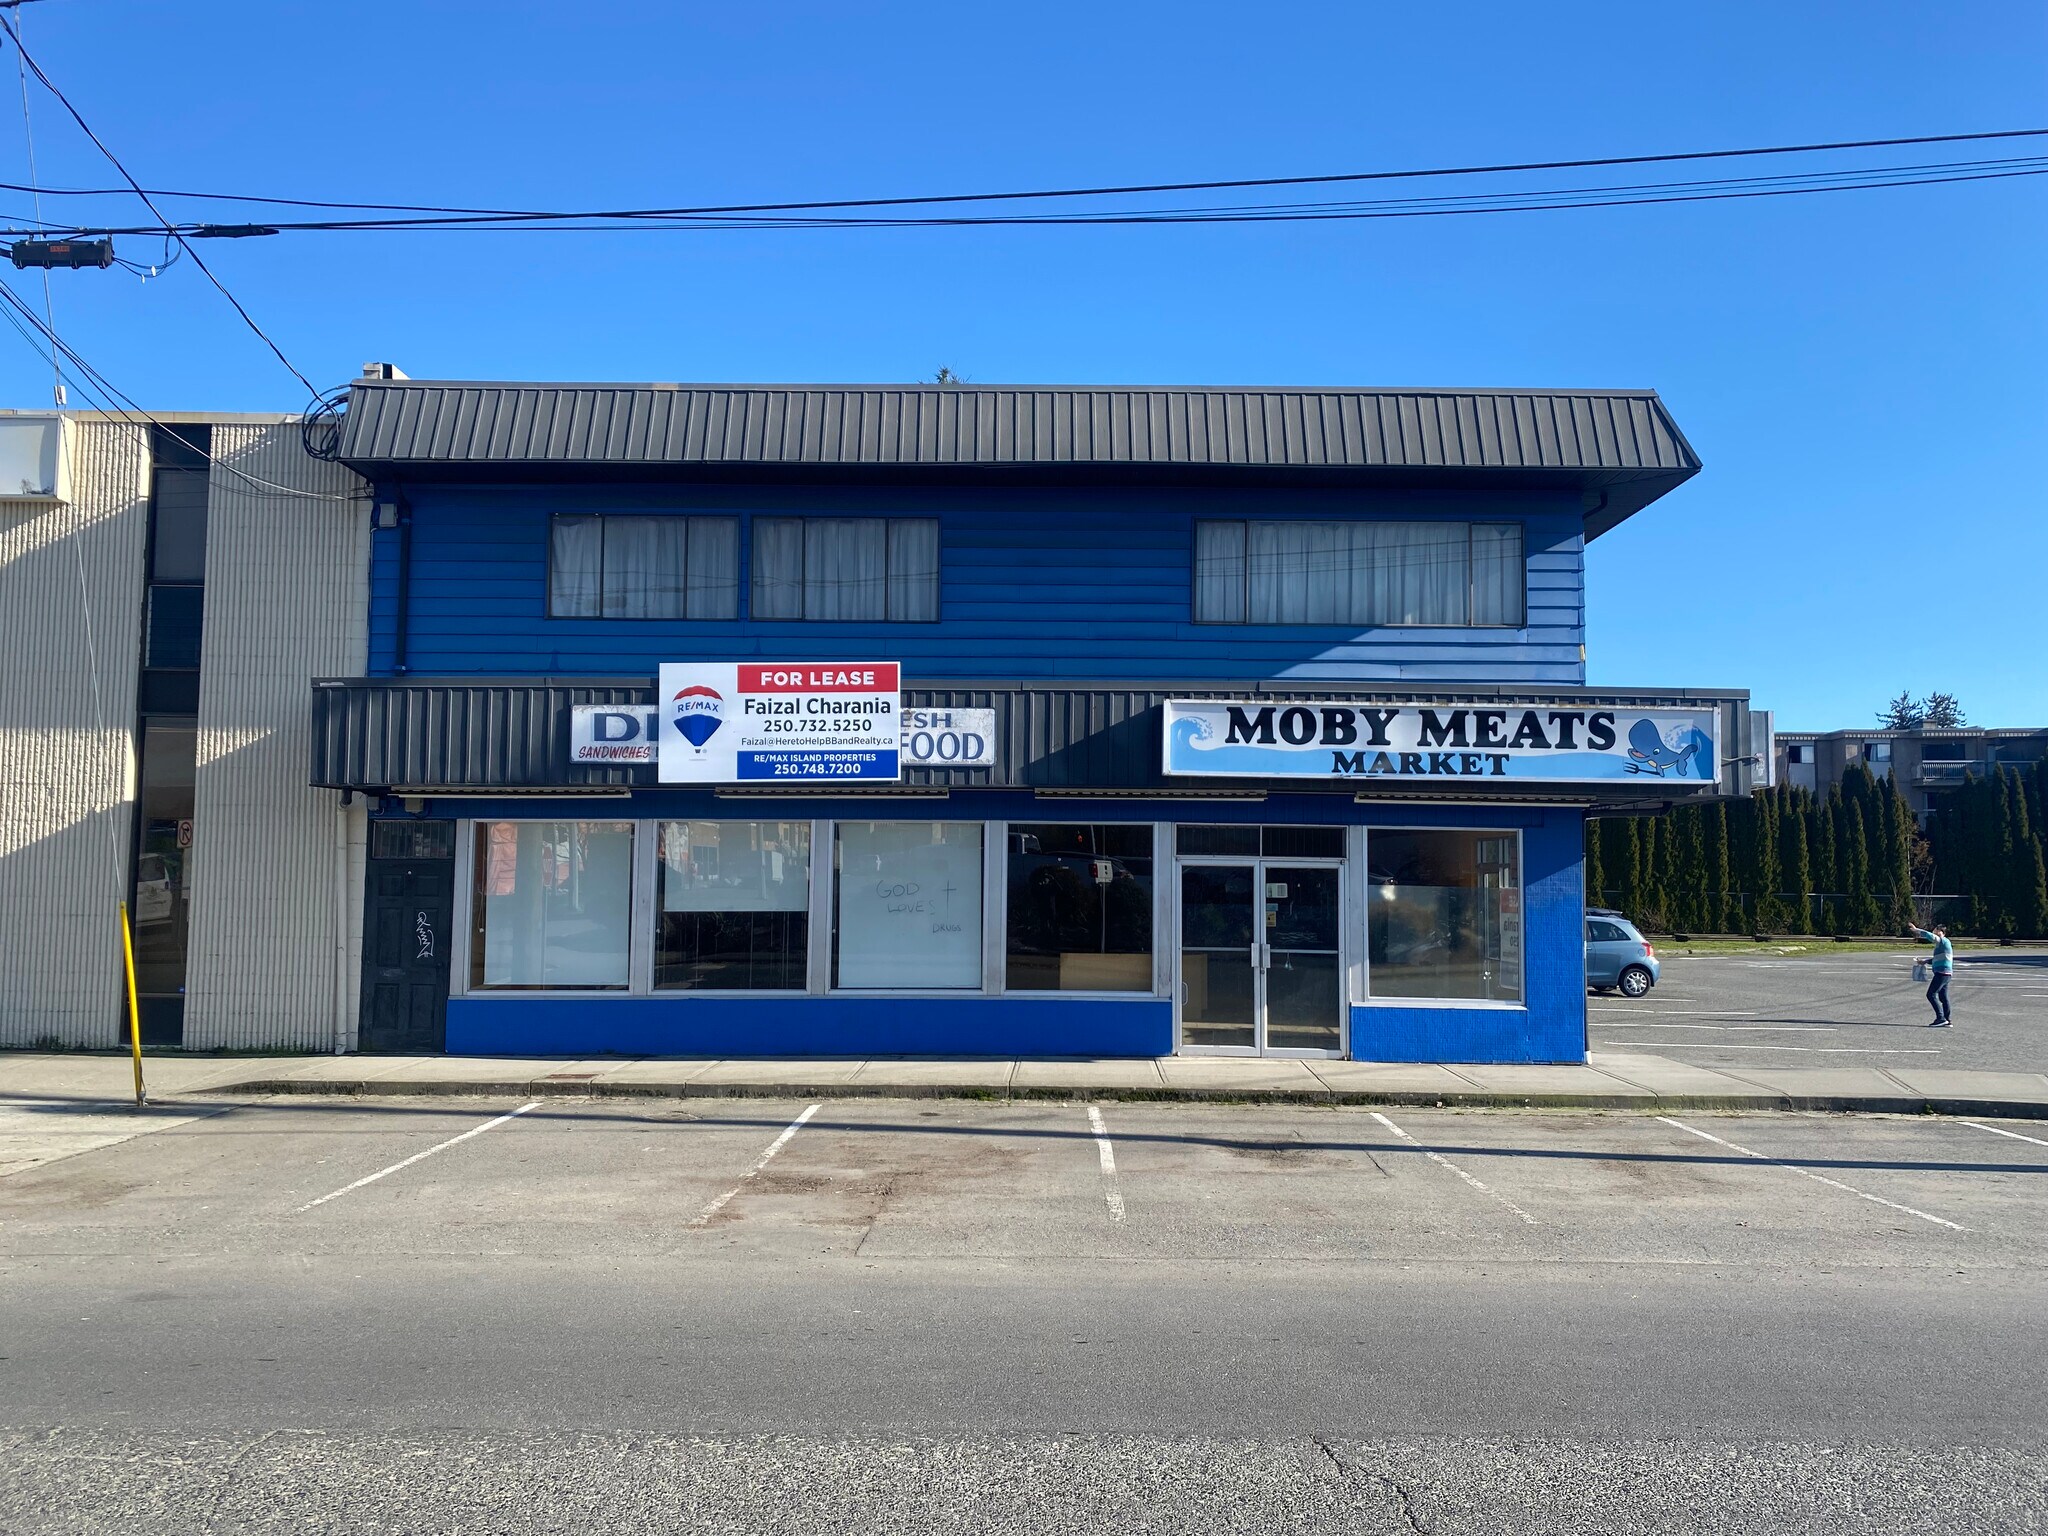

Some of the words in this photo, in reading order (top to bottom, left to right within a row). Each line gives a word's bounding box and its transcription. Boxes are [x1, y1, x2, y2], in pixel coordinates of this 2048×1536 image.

[760, 671, 803, 686] FOR
[809, 671, 875, 686] LEASE
[677, 700, 719, 713] RE/MAX
[744, 697, 801, 715] Faizal
[806, 697, 891, 715] Charania
[763, 719, 872, 732] 250.732.5250
[1224, 706, 1400, 746] MOBY
[1416, 709, 1617, 751] MEATS
[741, 736, 893, 747] Faizal@HeretoHelpBBandRealty.ca
[578, 745, 651, 759] SANDWICHES
[754, 754, 788, 763] RE/MAX
[790, 753, 822, 762] ISLAND
[824, 753, 877, 762] PROPERTIES
[774, 763, 861, 775] 250.748.7200
[1331, 751, 1510, 776] MARKET
[876, 880, 920, 899] GOD
